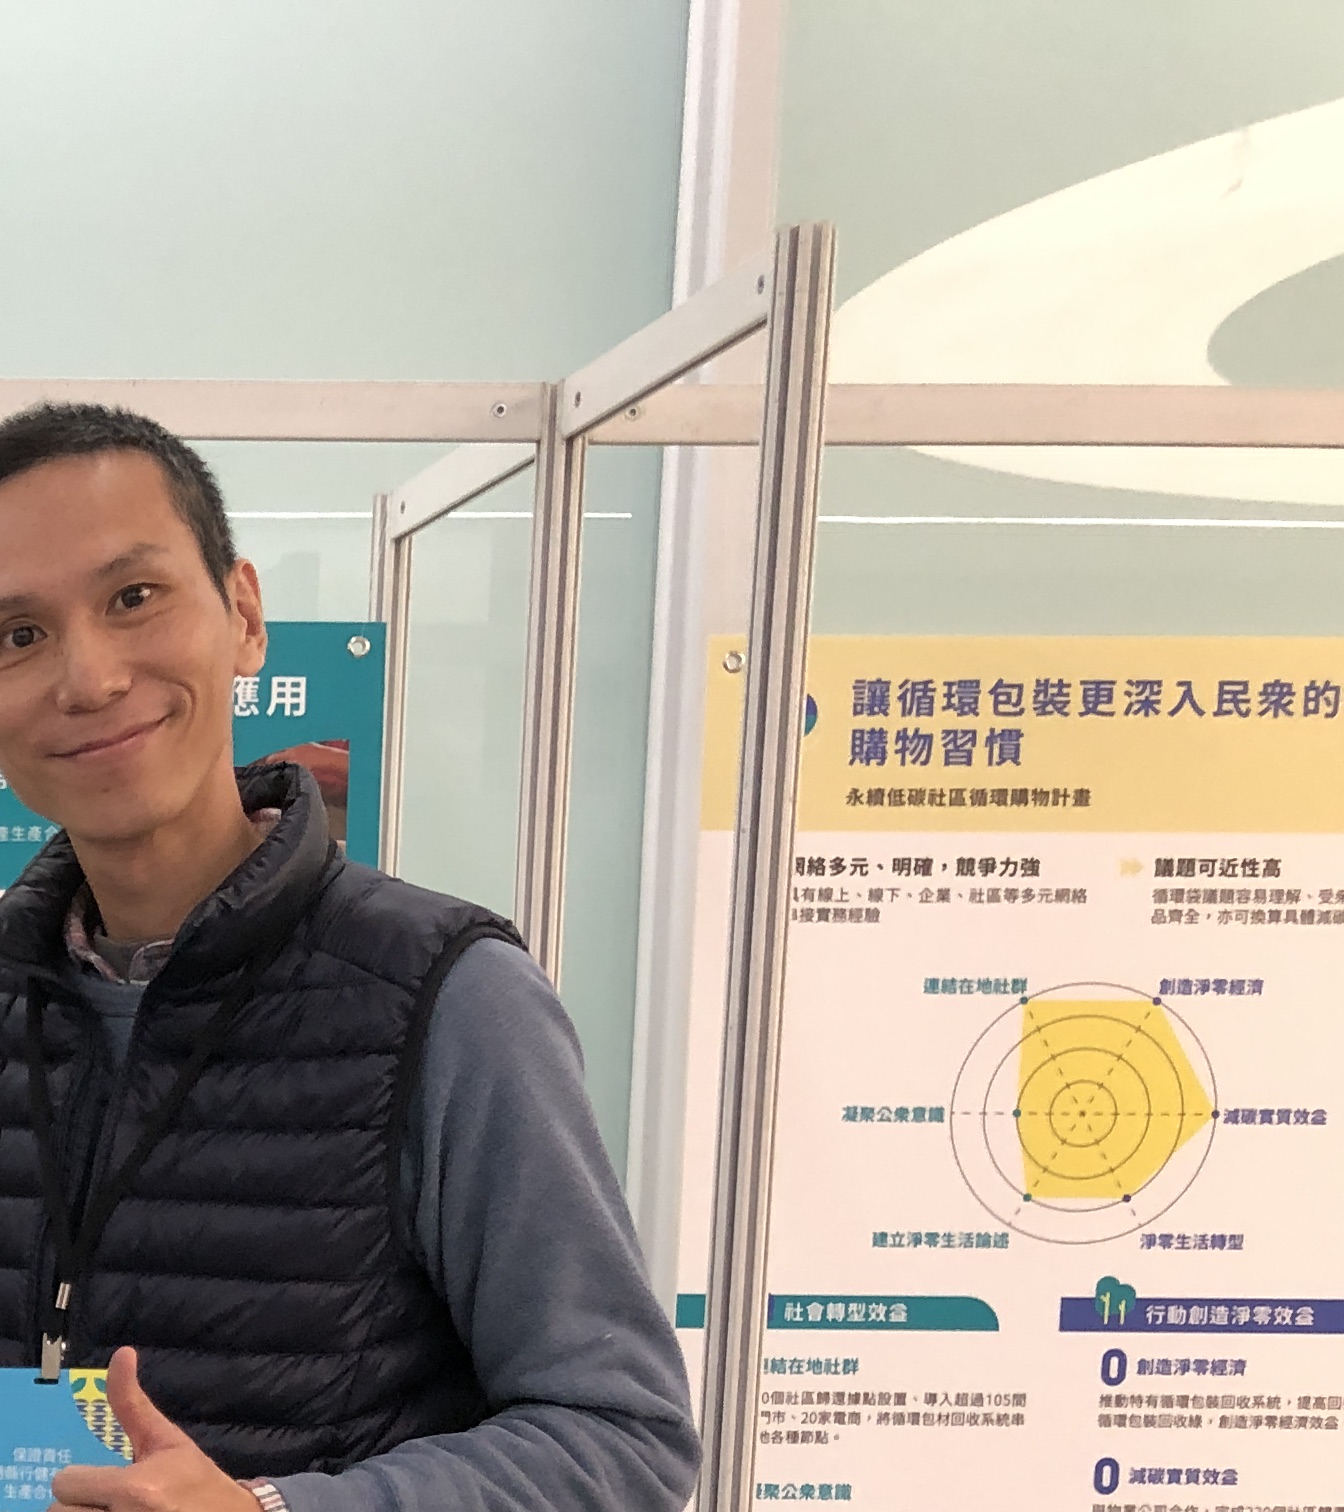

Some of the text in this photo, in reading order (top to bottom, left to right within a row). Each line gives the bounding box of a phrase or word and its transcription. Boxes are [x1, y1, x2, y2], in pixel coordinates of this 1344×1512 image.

[848, 727, 1022, 767] 購物習慣
[846, 787, 1090, 808] 永續低碳社區循環購物計畫
[1155, 858, 1281, 879] 議題可近性高
[923, 977, 1027, 996] 連結在地社群
[1159, 978, 1263, 997] 創造淨零經濟
[1224, 1108, 1327, 1126] 減碳實質效益
[872, 1230, 1009, 1250] 建立淨零生活論述
[1141, 1232, 1244, 1251] 淨零生活轉型
[785, 1303, 908, 1323] 社會轉型效益
[1146, 1305, 1314, 1327] 行動創造淨零效益
[764, 1357, 859, 1375] 結在地社群
[1137, 1358, 1247, 1377] 創造淨零經濟
[13, 1448, 71, 1464] 保證責任
[1129, 1468, 1238, 1486] 減碳實質效益
